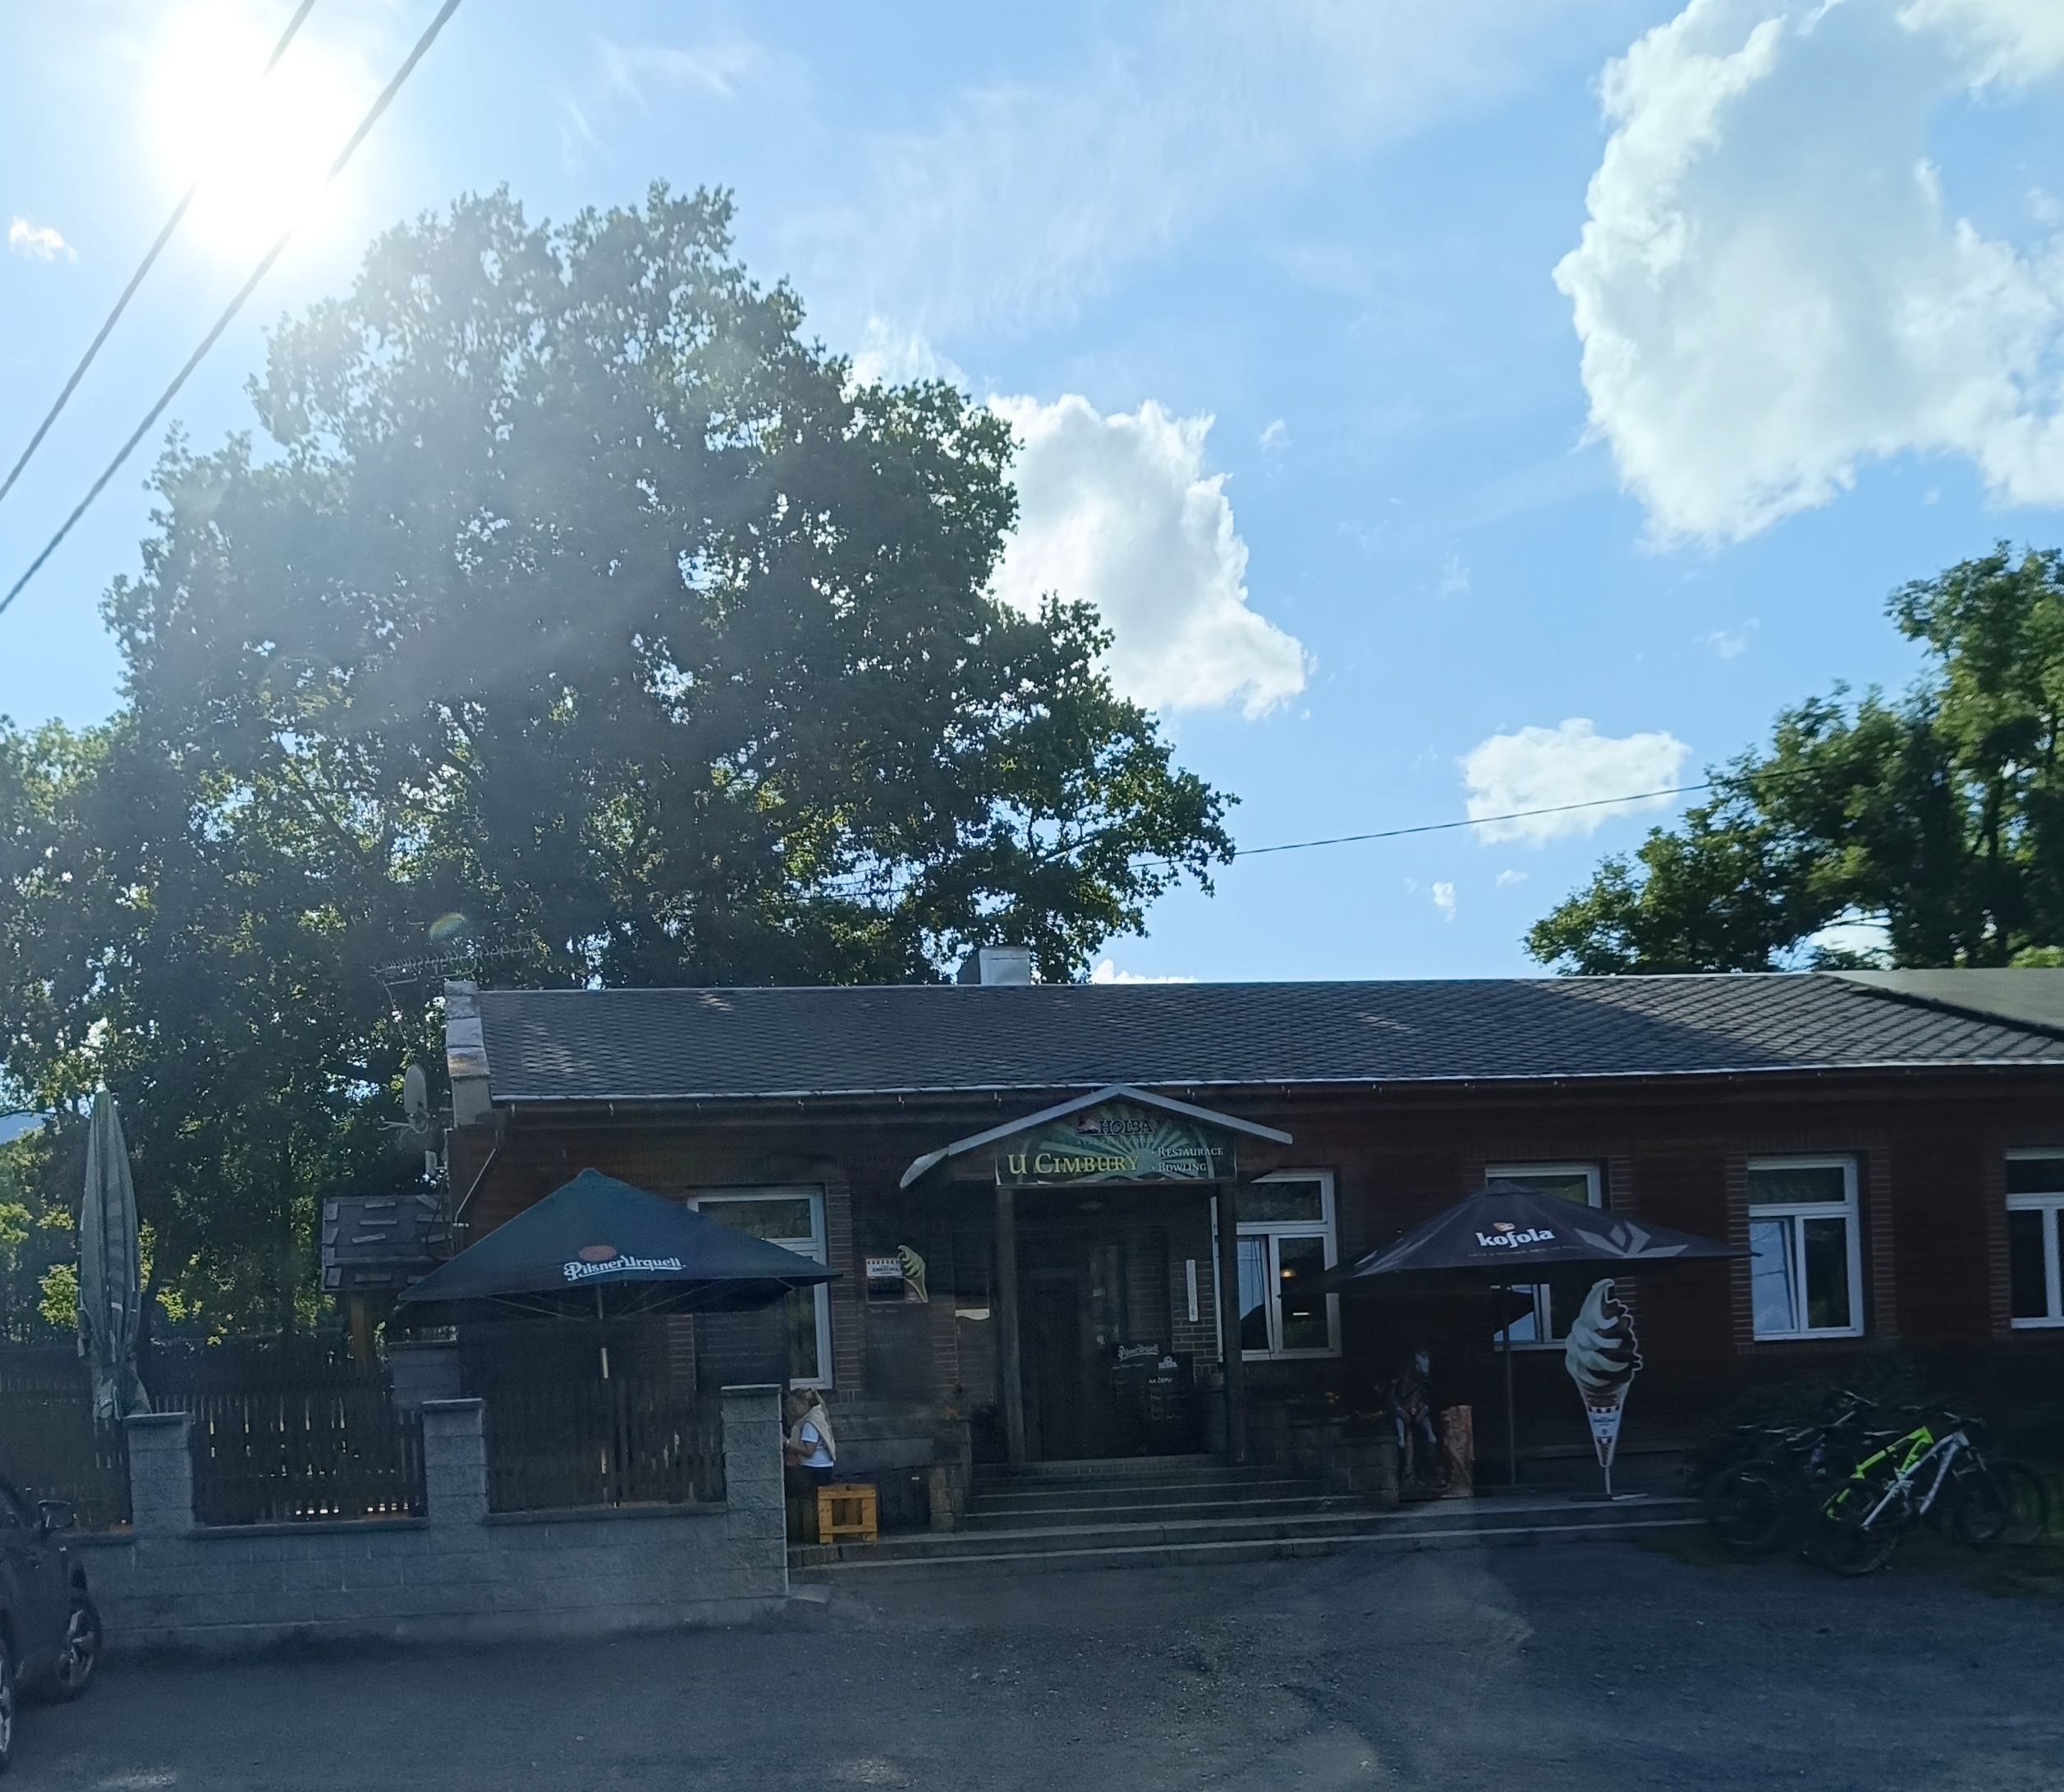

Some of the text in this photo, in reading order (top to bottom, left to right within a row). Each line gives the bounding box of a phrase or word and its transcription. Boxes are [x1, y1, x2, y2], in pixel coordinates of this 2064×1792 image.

[1099, 1120, 1154, 1134] HOLBA
[1158, 1147, 1223, 1157] RESTAURACE
[1007, 1153, 1139, 1175] U CIMBURY
[1158, 1162, 1207, 1172] BOWLING
[1475, 1228, 1556, 1249] kofola
[563, 1255, 682, 1281] Pilsner Urquell
